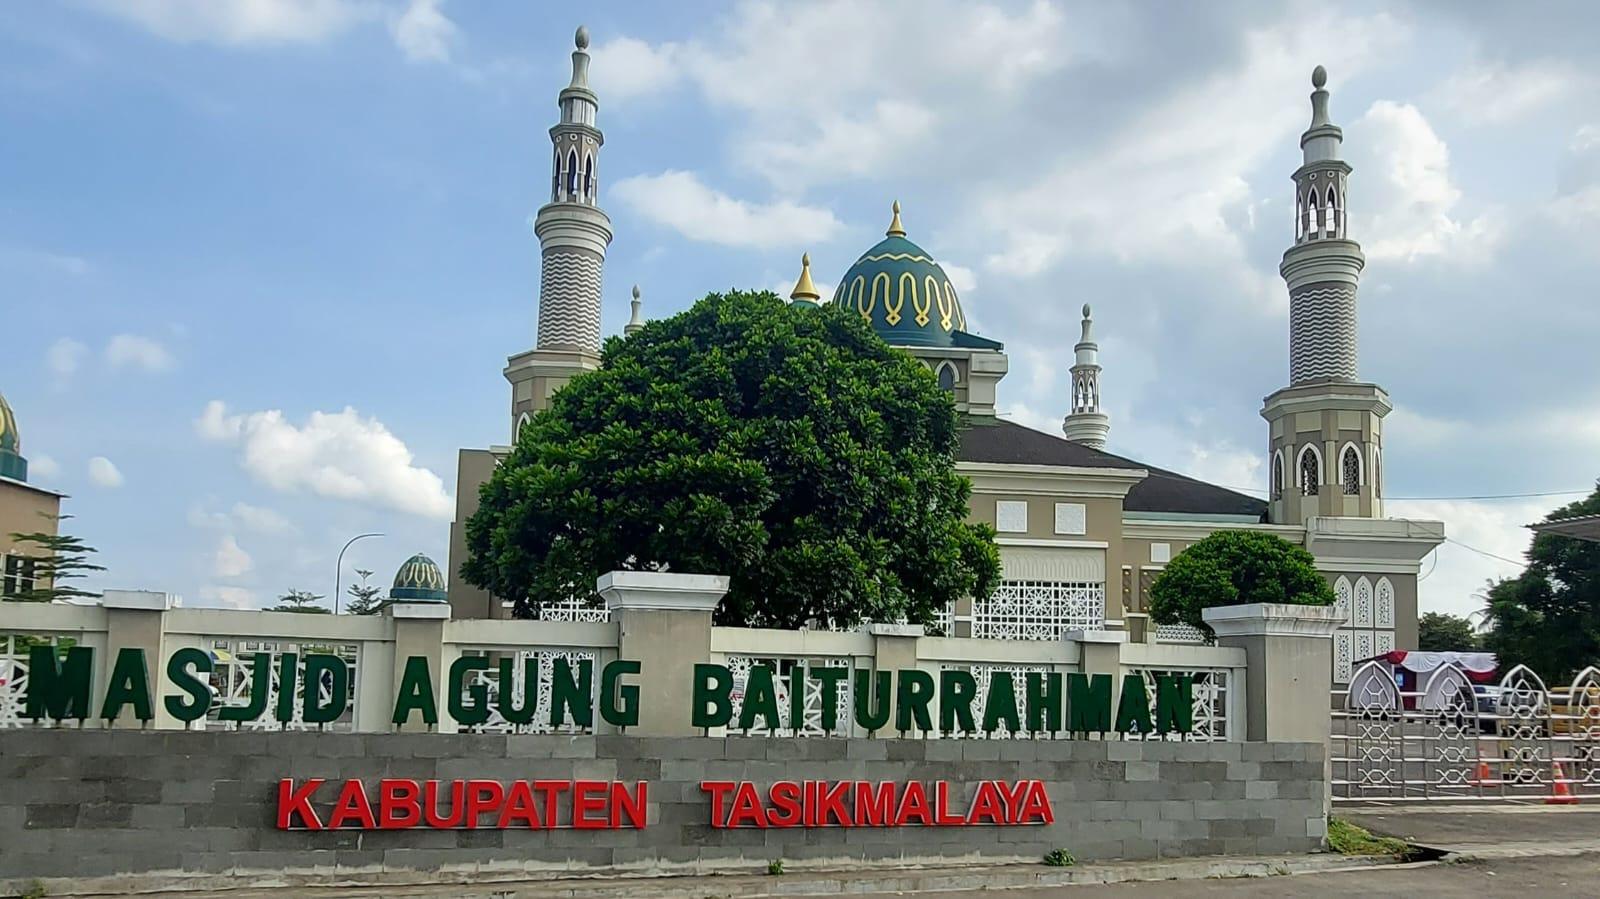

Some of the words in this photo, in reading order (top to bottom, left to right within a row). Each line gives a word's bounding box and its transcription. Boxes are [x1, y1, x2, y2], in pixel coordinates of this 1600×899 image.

[27, 644, 348, 722] MASJID
[392, 656, 641, 726] AGUNG
[693, 663, 1193, 732] BAITURRAHMAN
[277, 778, 648, 829] KABUPATEN
[701, 780, 1054, 828] TASIKMALAYA
